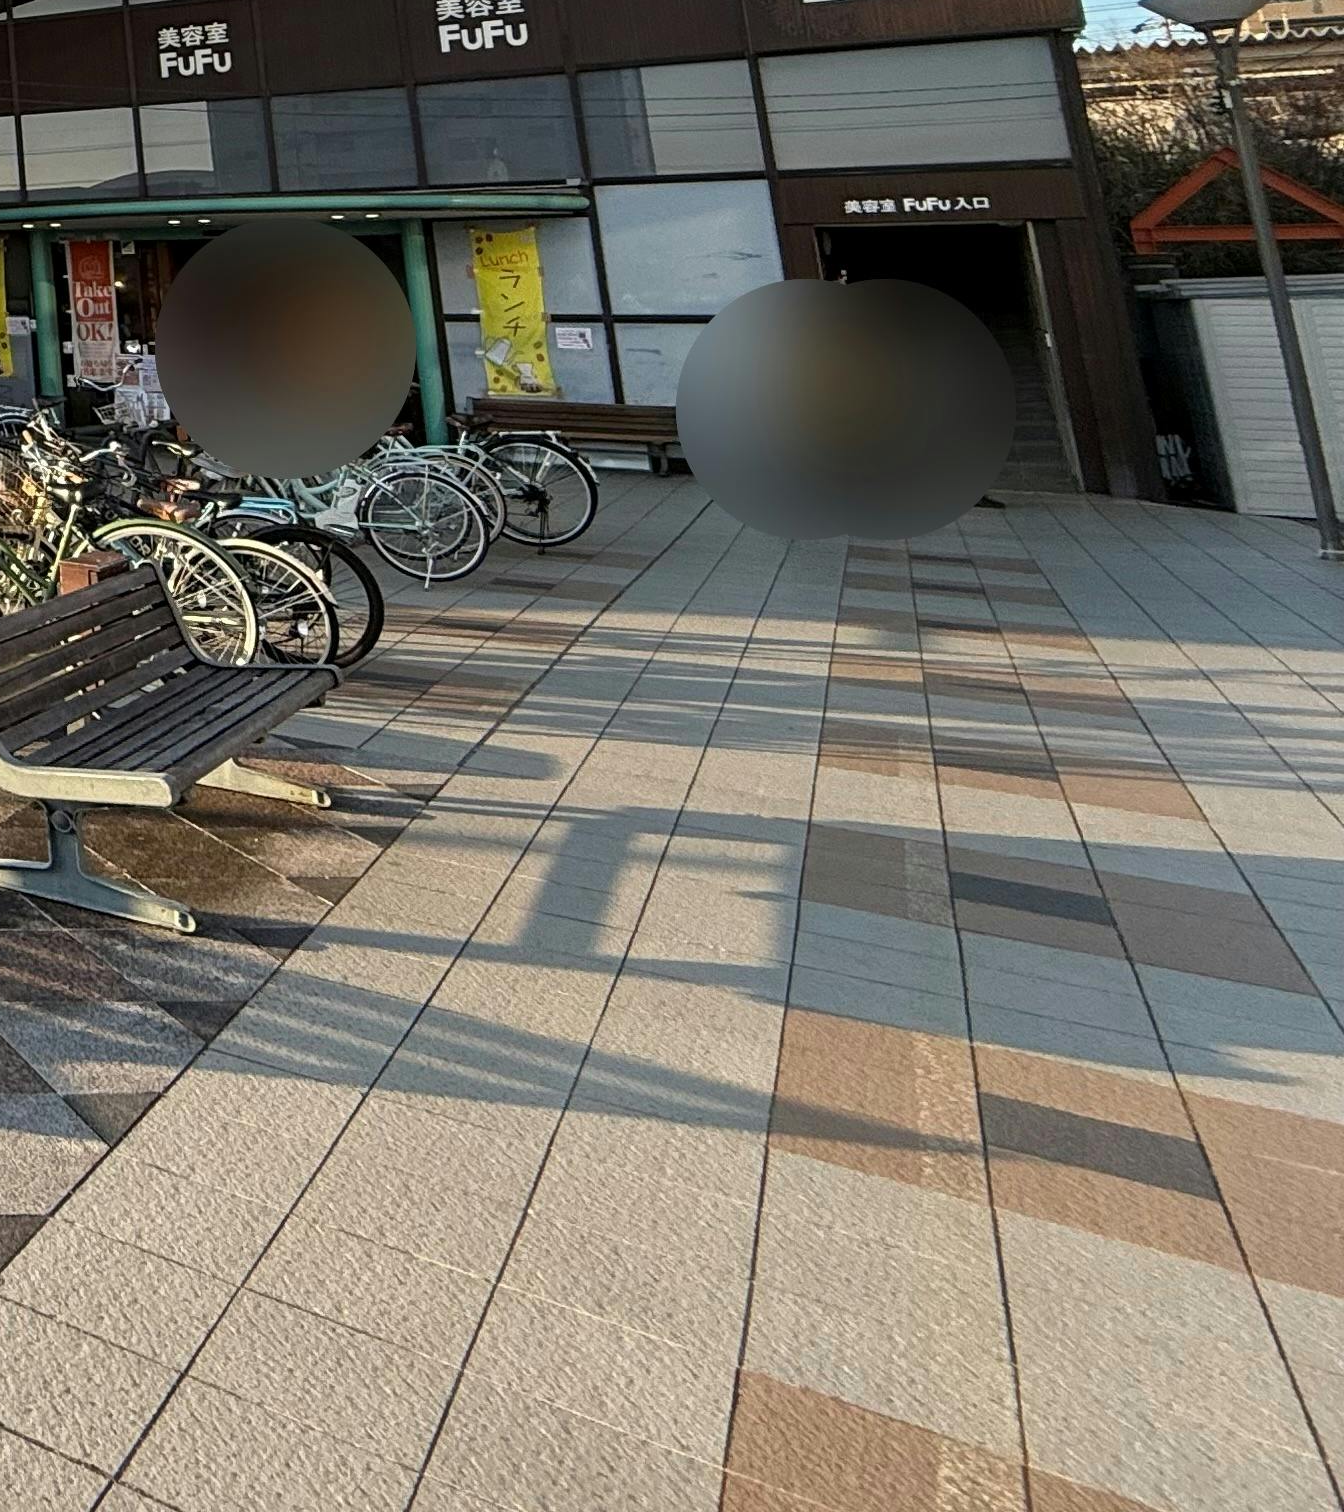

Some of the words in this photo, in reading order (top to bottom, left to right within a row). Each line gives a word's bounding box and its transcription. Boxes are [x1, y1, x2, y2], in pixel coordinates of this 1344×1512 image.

[158, 21, 230, 49] 美容室
[438, 19, 529, 53] FuFu
[159, 48, 233, 79] FuFu
[844, 199, 897, 214] 美容室
[903, 197, 952, 213] FuFu
[954, 197, 990, 211] 入口
[480, 250, 529, 267] Lunch
[73, 281, 112, 298] Take
[76, 297, 112, 318] Out
[499, 269, 526, 336] ランチ
[77, 323, 113, 341] OK!
